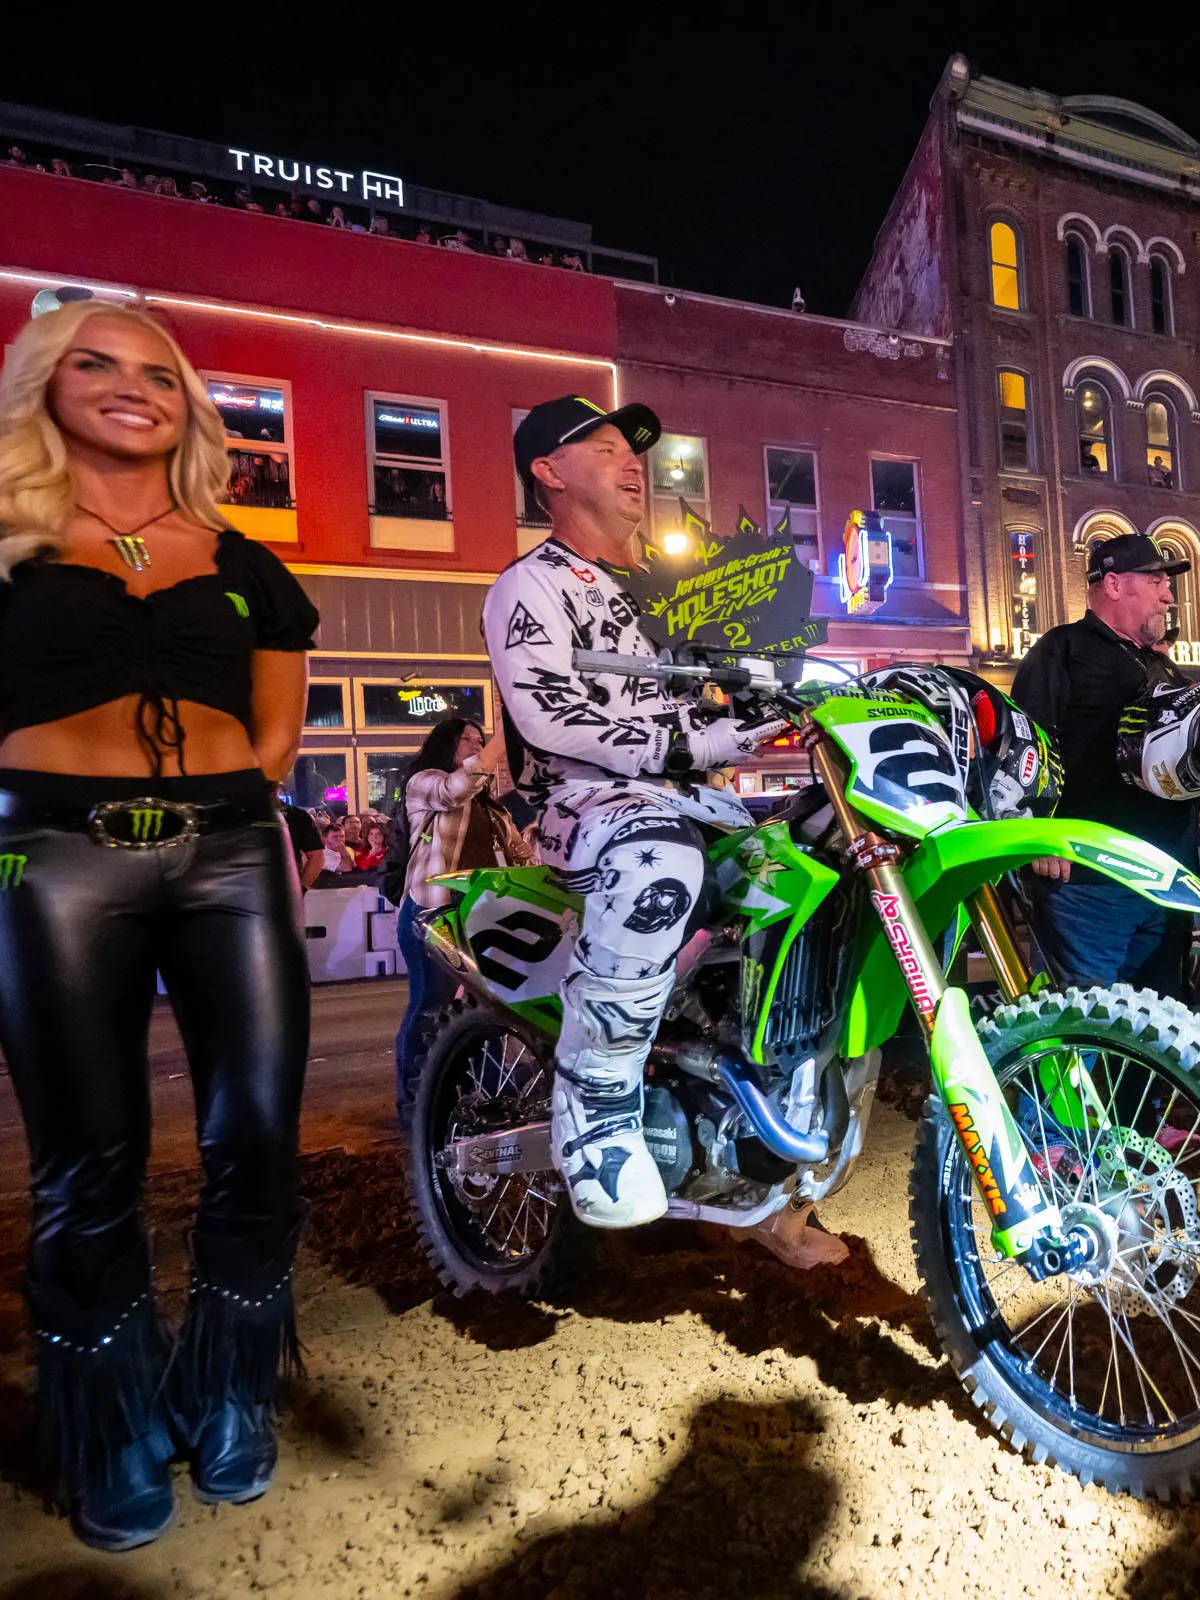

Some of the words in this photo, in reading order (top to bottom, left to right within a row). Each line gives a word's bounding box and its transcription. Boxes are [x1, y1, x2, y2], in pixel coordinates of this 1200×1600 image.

[229, 149, 354, 192] TRUIST
[411, 418, 438, 428] ULTRA
[667, 558, 792, 637] HOLESHOT
[670, 566, 724, 601] Jeremy
[867, 707, 928, 721] SHOWTIME
[652, 729, 663, 761] breathe
[869, 722, 965, 809] 2
[1023, 751, 1035, 779] BELL
[613, 819, 681, 841] CASH
[1096, 853, 1158, 880] Kawasaki
[469, 910, 563, 991] 2
[884, 922, 936, 1015] SHOWA
[948, 1102, 1007, 1217] MAXXIS
